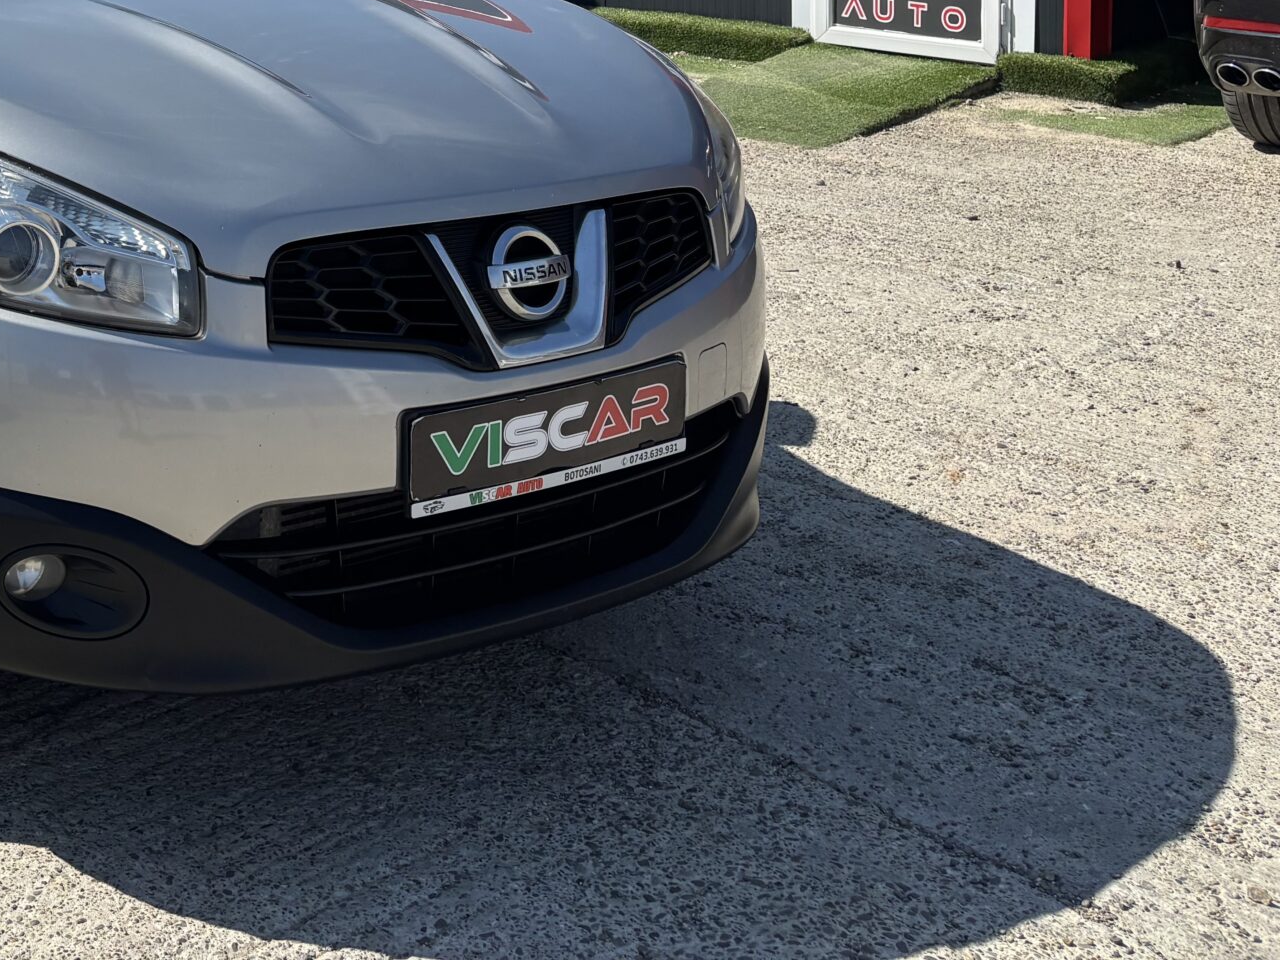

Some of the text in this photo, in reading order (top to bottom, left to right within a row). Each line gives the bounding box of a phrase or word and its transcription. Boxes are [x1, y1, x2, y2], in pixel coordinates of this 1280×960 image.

[502, 261, 567, 284] NISSAN
[430, 383, 670, 476] VISCAR
[469, 443, 678, 505] VISCAR AUTO BOTOSANI 0743.639.931
